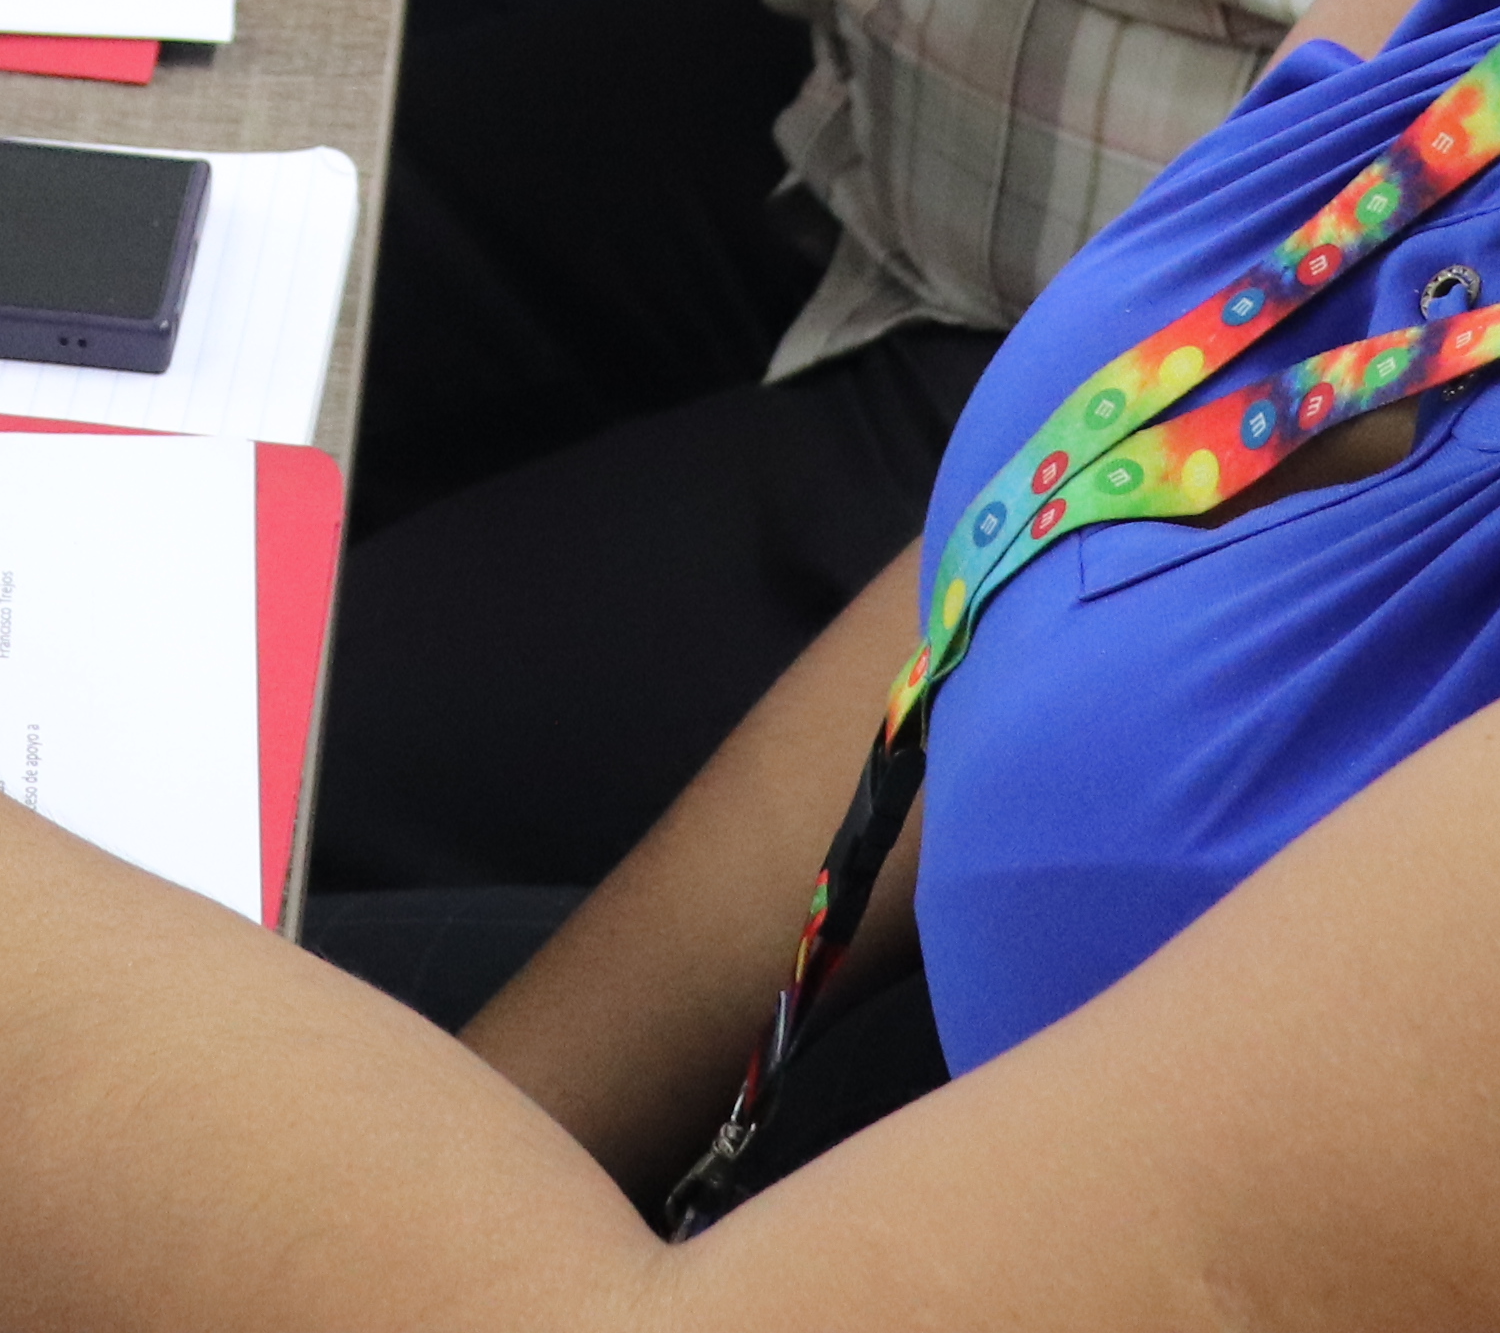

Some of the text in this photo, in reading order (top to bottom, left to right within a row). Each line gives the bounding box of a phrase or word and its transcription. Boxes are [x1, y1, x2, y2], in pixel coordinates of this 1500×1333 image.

[1431, 132, 1454, 154] m
[1366, 193, 1389, 213] m
[1308, 253, 1329, 276] m
[1232, 297, 1252, 317] m
[1455, 330, 1472, 348] m
[1376, 356, 1396, 377] m
[1095, 399, 1115, 418] m
[1307, 395, 1323, 417] m
[1249, 412, 1267, 438] m
[1041, 462, 1058, 483] m
[1107, 468, 1131, 487] m
[981, 513, 998, 535] m
[1039, 509, 1055, 528] m
[25, 733, 42, 766] apoyo
[21, 769, 38, 783] de
